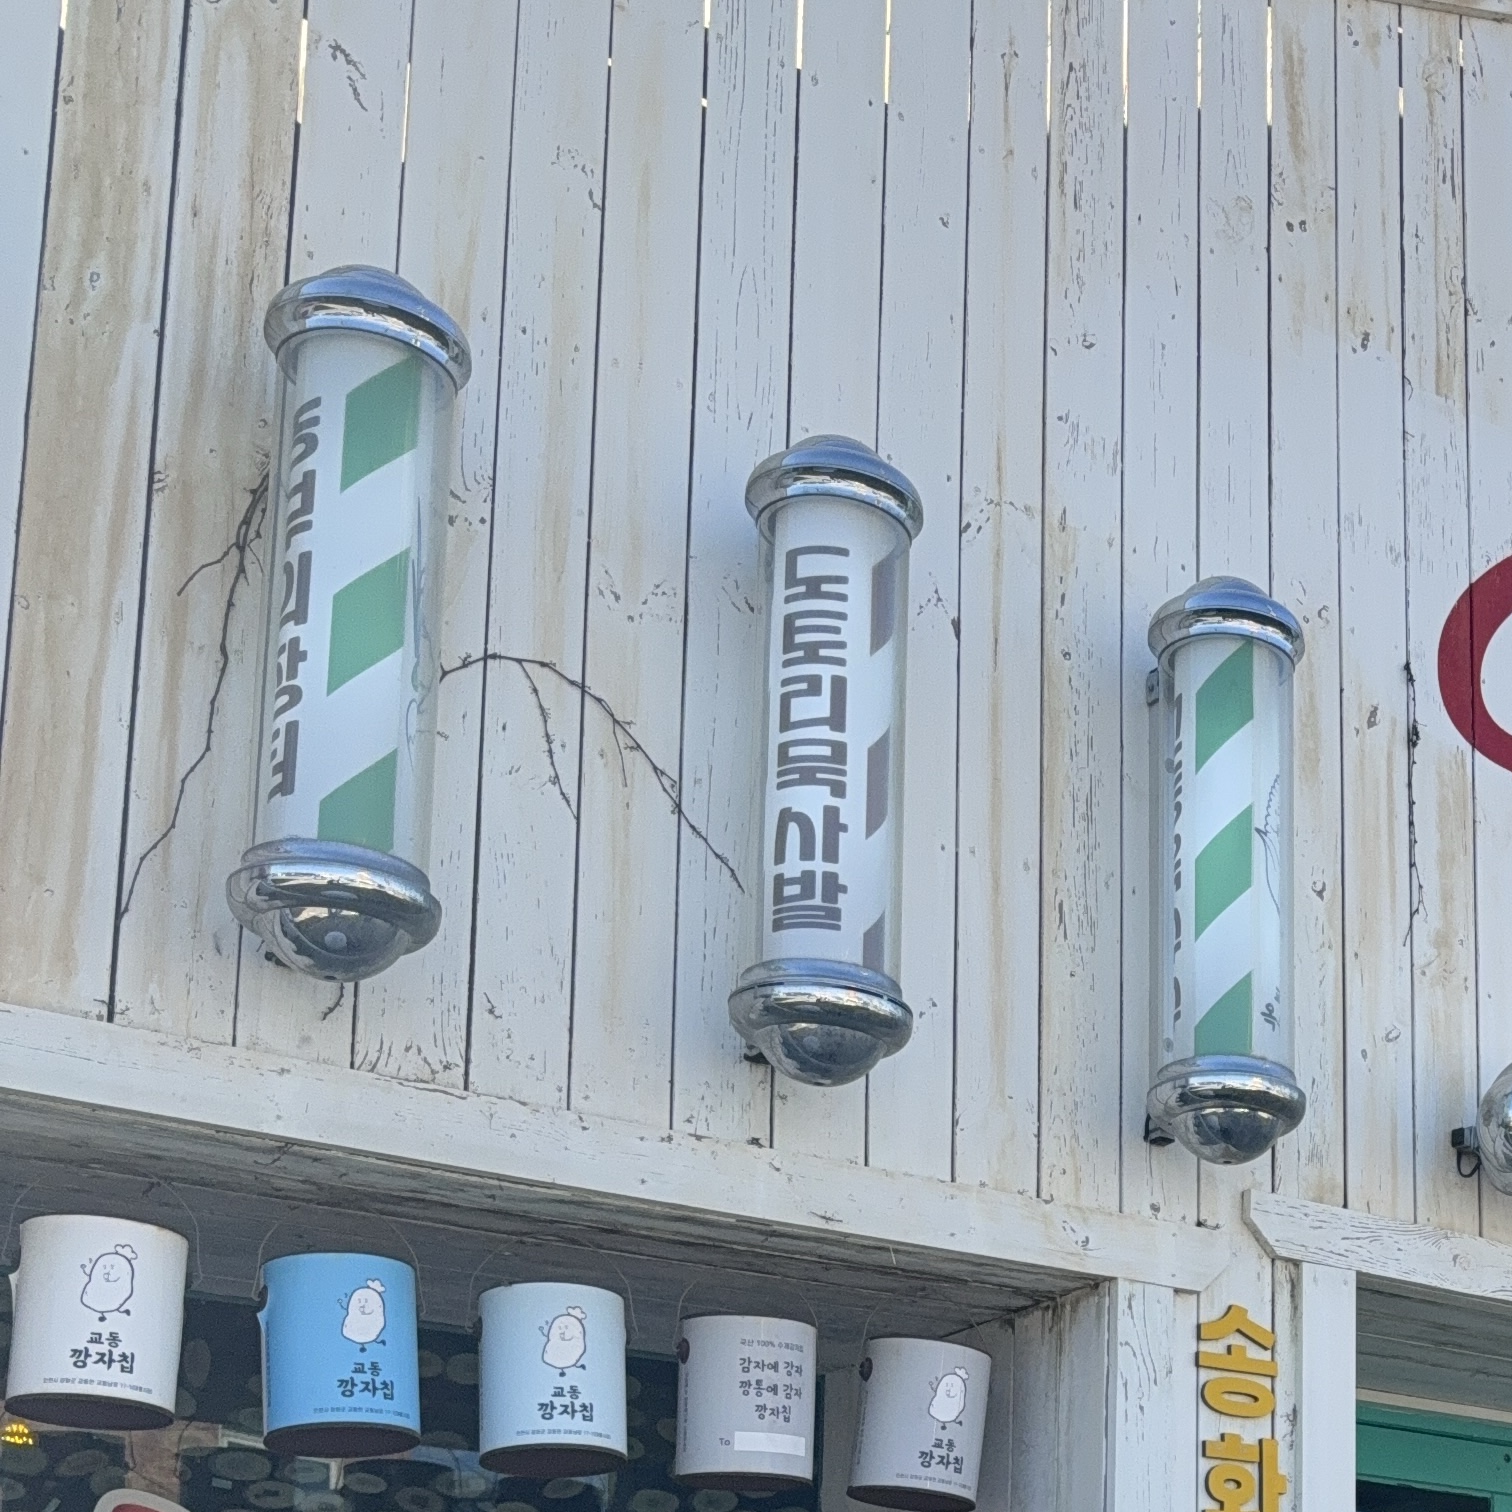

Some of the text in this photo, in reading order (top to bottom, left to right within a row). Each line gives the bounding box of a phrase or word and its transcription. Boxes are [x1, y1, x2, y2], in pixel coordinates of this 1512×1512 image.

[772, 545, 850, 933] 도토리묵사발
[86, 1332, 122, 1348] 교동
[69, 1347, 135, 1375] 깡자칩
[351, 1361, 382, 1377] 교동
[739, 1356, 779, 1374] 감자에
[337, 1376, 395, 1401] 깡자칩
[551, 1385, 582, 1400] 교동
[739, 1379, 779, 1397] 깡통에
[537, 1400, 594, 1423] 깡자칩
[754, 1403, 792, 1423] 깡자칩
[719, 1438, 731, 1446] To
[931, 1438, 957, 1452] 교동
[918, 1450, 964, 1475] 깡자칩
